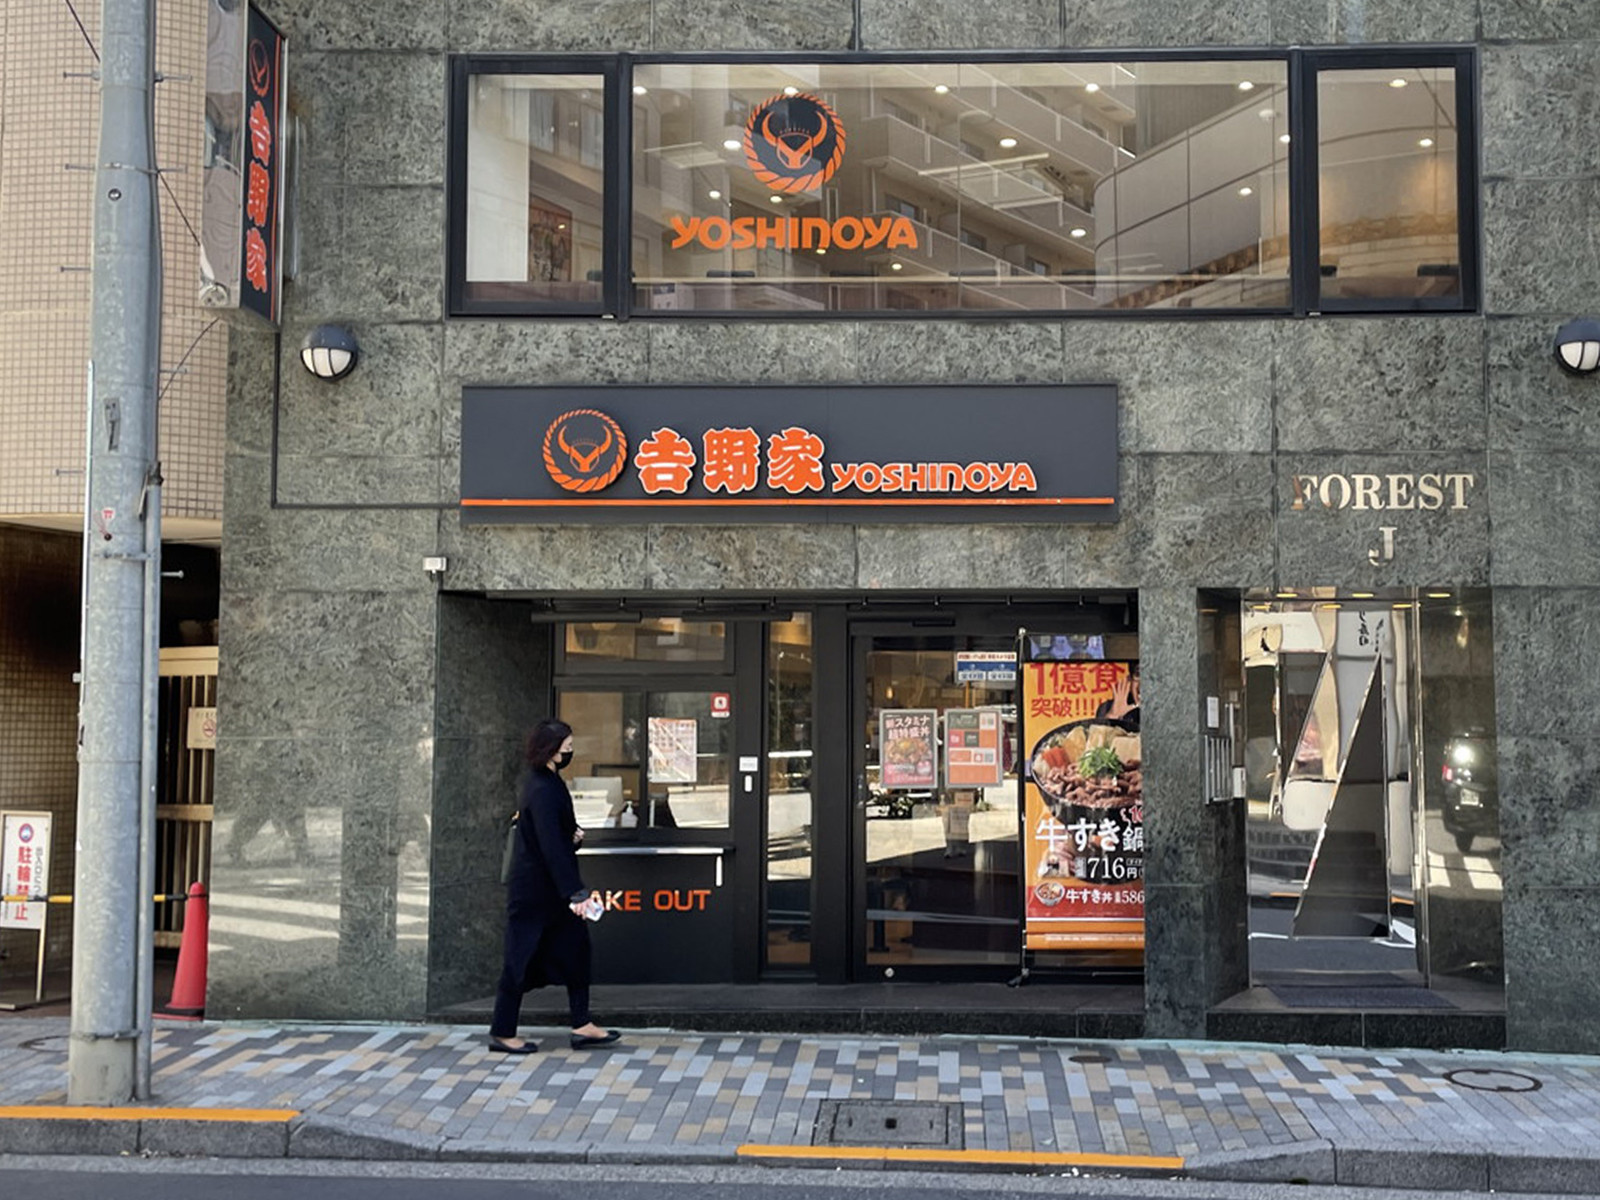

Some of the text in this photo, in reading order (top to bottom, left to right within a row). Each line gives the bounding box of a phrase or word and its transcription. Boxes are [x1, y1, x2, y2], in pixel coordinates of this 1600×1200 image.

[247, 100, 271, 293] 吉野家
[669, 216, 919, 250] YOSHINOYA
[634, 426, 1038, 496] 吉野家 YOSHINOYA
[1291, 473, 1474, 510] FOREST
[1368, 526, 1398, 567] J
[1030, 662, 1126, 696] 1億食
[1035, 817, 1143, 852] 牛すき鍋
[589, 889, 712, 912] AKE OUT
